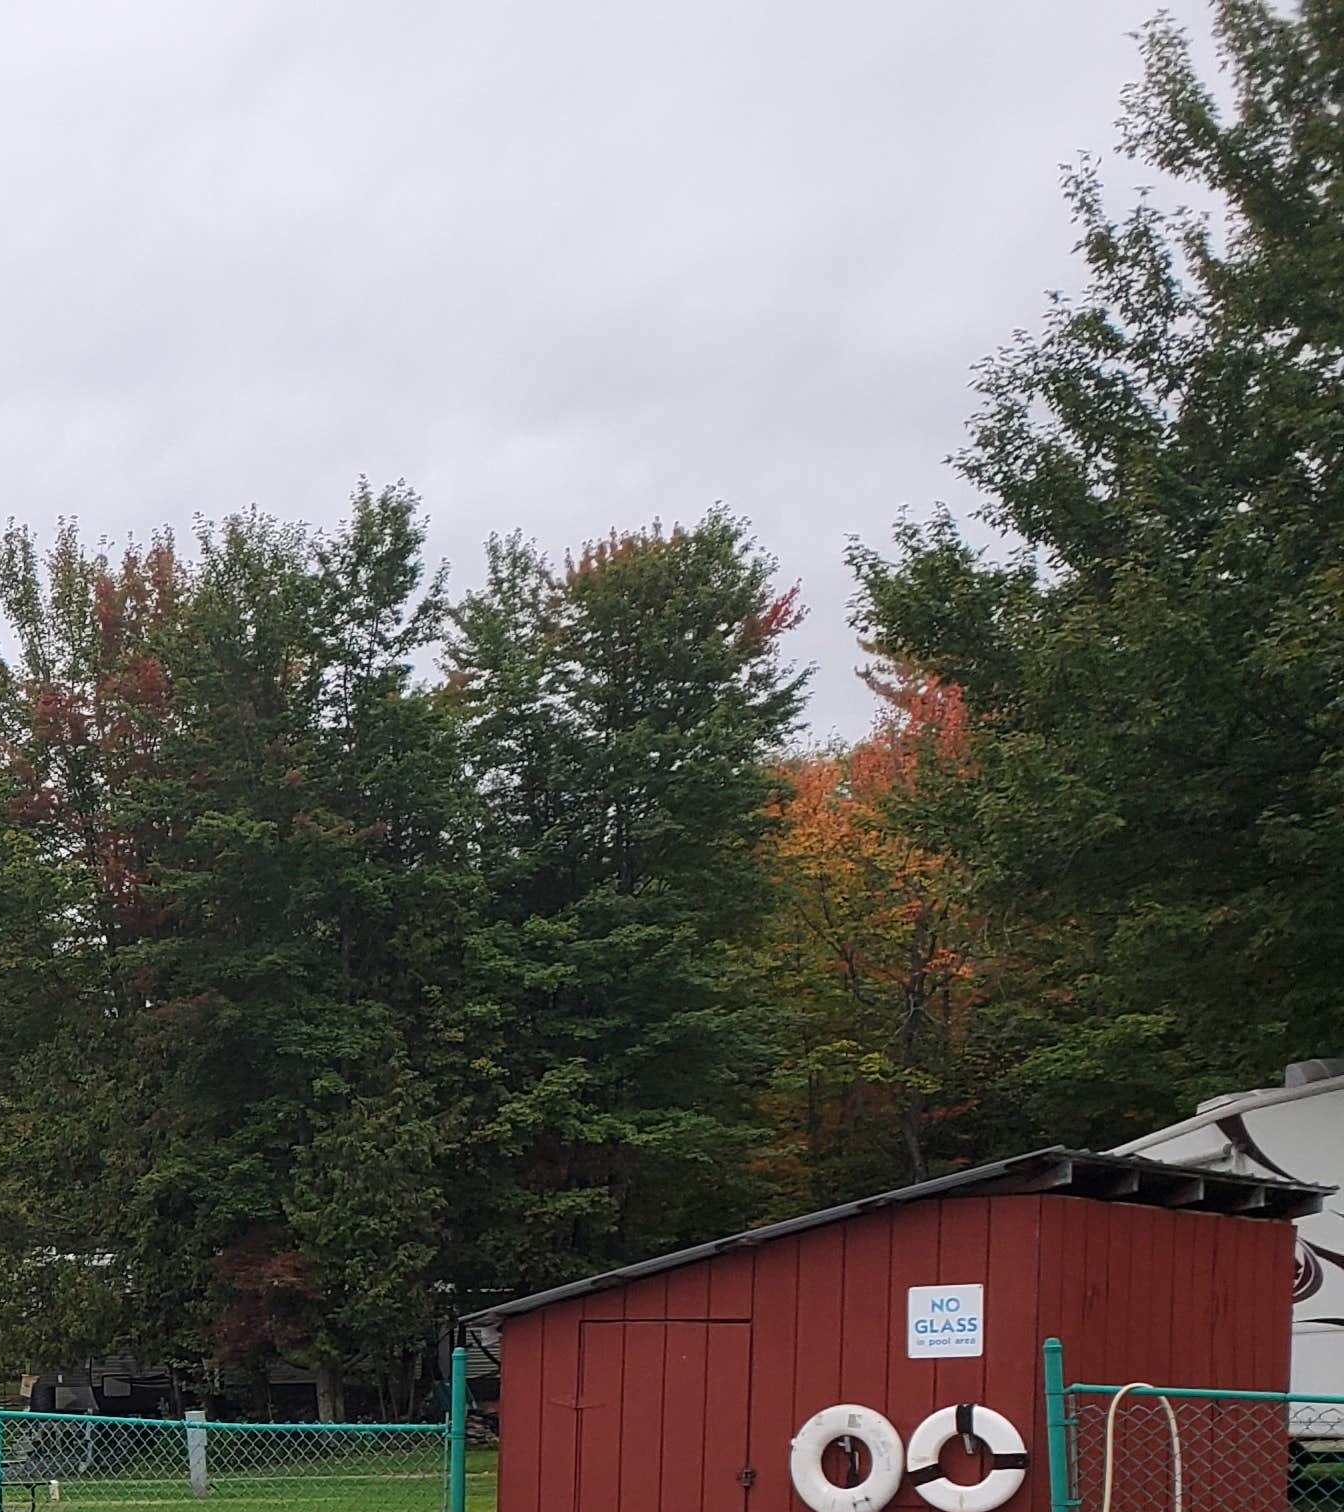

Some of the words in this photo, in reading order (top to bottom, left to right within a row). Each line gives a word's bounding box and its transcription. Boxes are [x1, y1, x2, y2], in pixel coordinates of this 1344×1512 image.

[931, 1297, 960, 1312] NO
[915, 1317, 977, 1334] GLASS
[929, 1336, 951, 1346] pool
